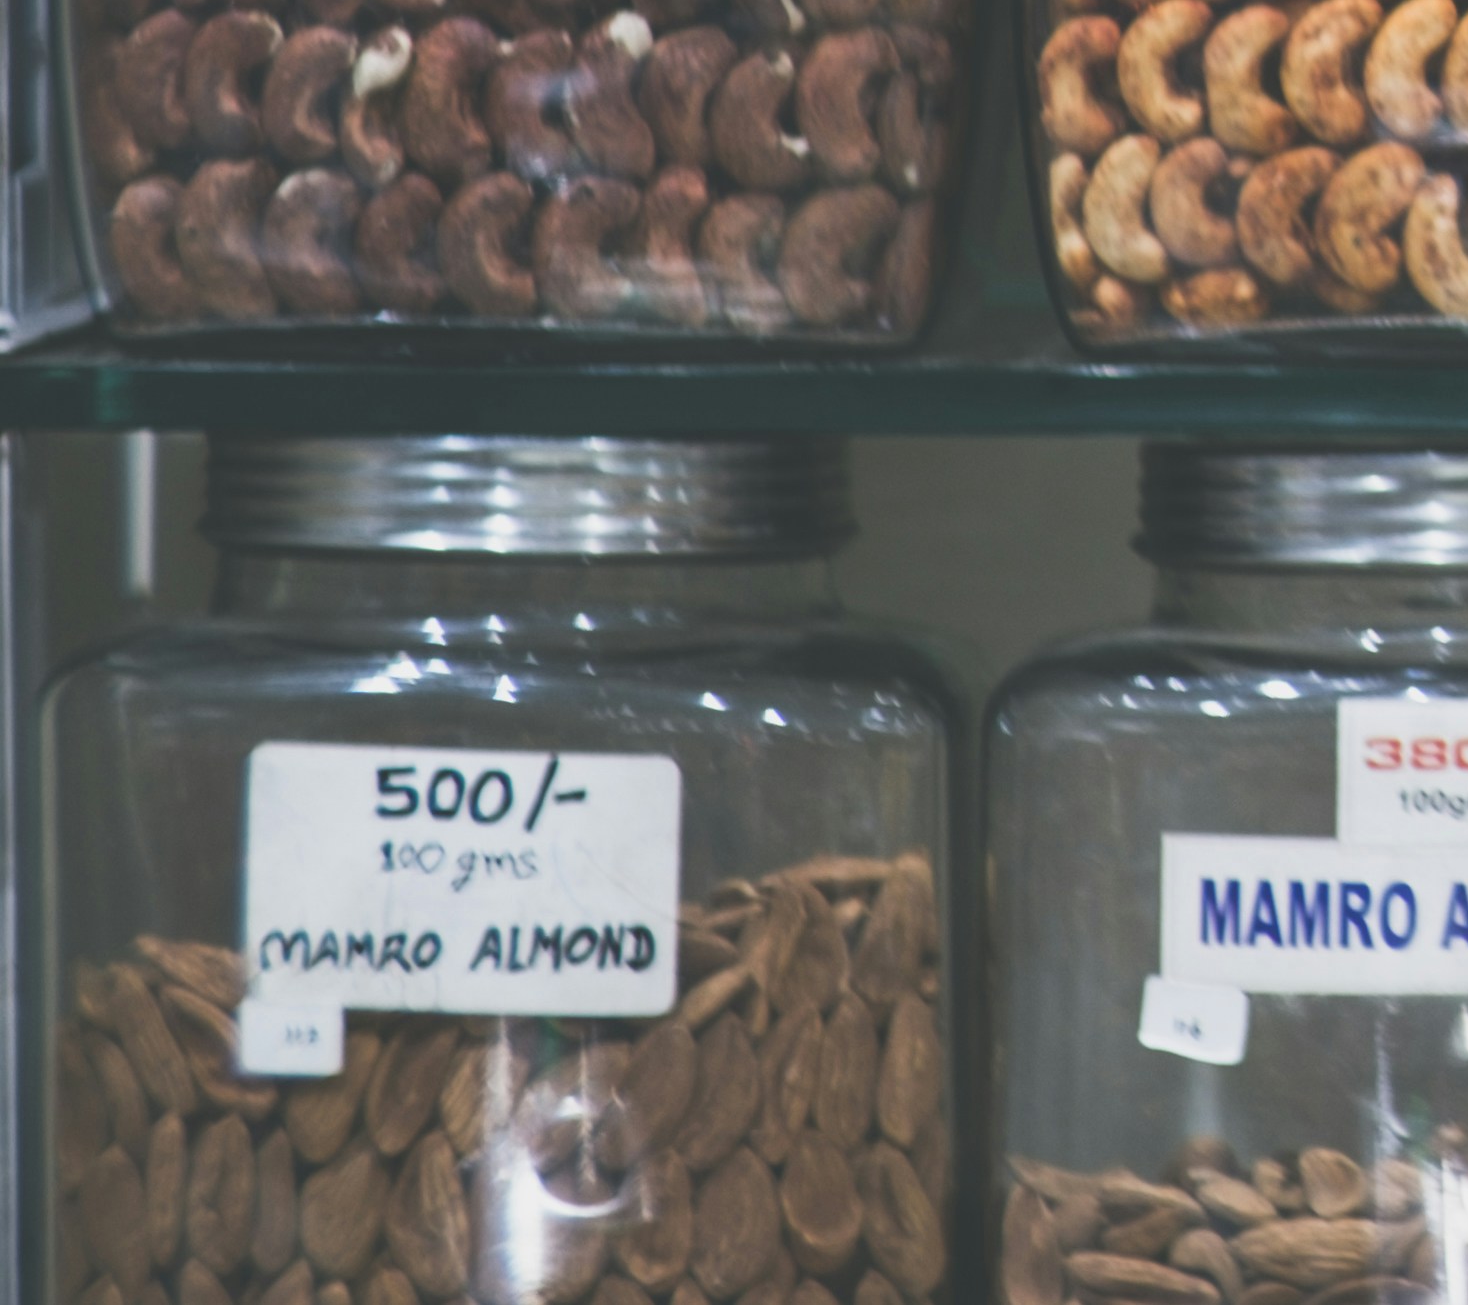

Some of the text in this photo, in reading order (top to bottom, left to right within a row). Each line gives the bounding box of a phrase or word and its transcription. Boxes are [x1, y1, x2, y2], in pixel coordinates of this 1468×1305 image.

[372, 755, 588, 834] 500/-
[259, 923, 657, 974] MAMRO ALMOND
[1200, 877, 1418, 950] MAMRO
